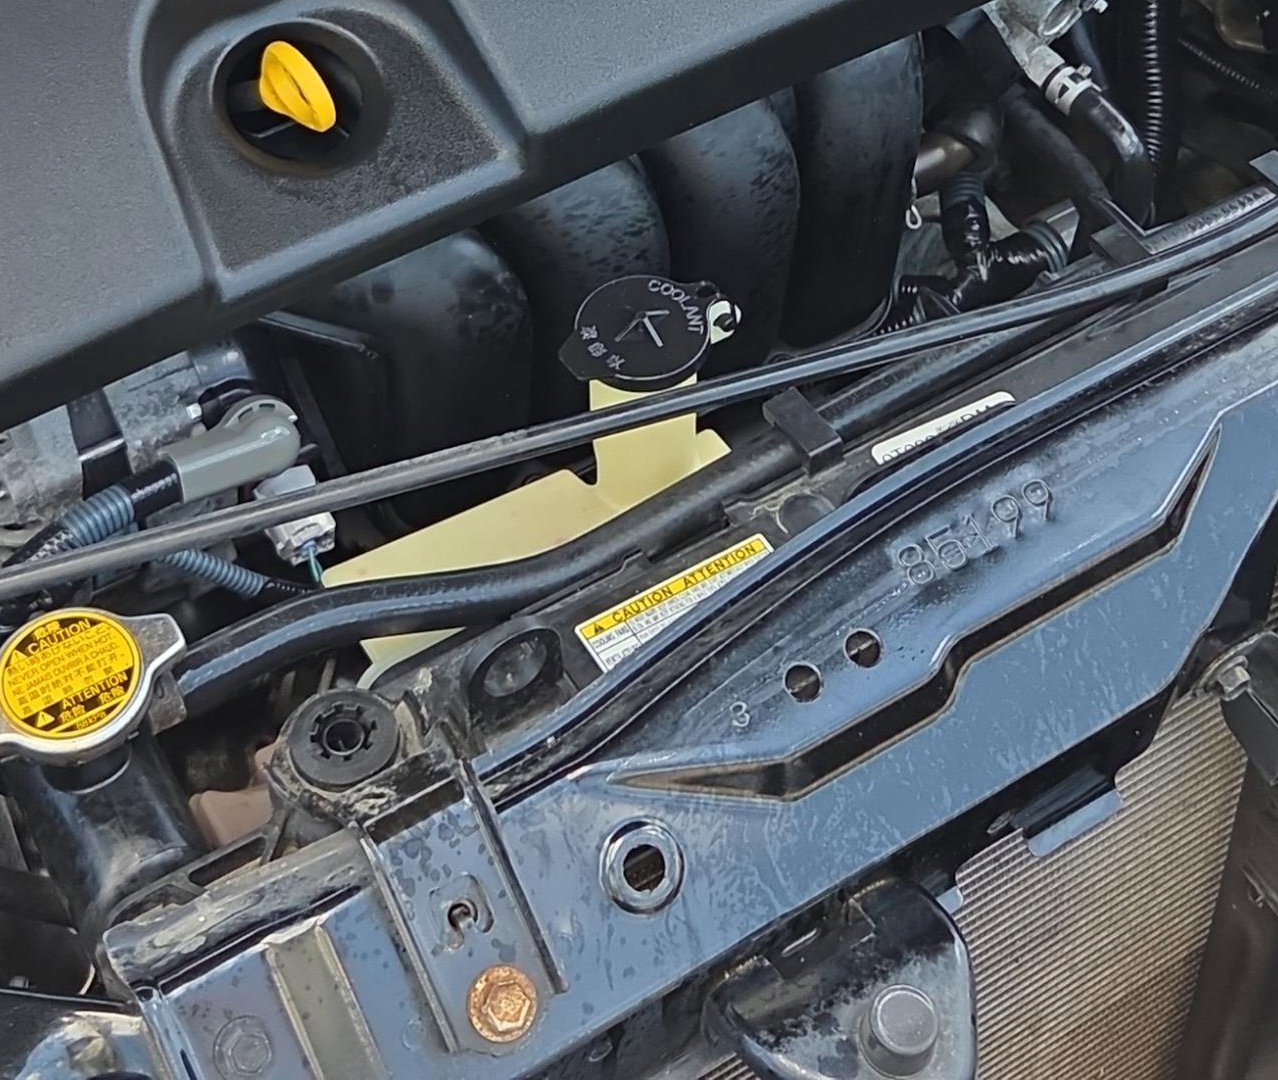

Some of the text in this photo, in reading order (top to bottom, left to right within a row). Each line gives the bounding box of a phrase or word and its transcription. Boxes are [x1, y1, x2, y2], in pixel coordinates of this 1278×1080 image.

[648, 279, 704, 335] COOLANT
[897, 478, 1054, 585] 85199
[610, 585, 674, 624] CAUTION
[681, 543, 756, 588] ATTENTION
[26, 618, 91, 654] CAUTION
[6, 666, 39, 686] NEVER
[38, 653, 65, 671] OPEN
[64, 641, 93, 659] WHEN
[60, 671, 128, 708] ATTENTION
